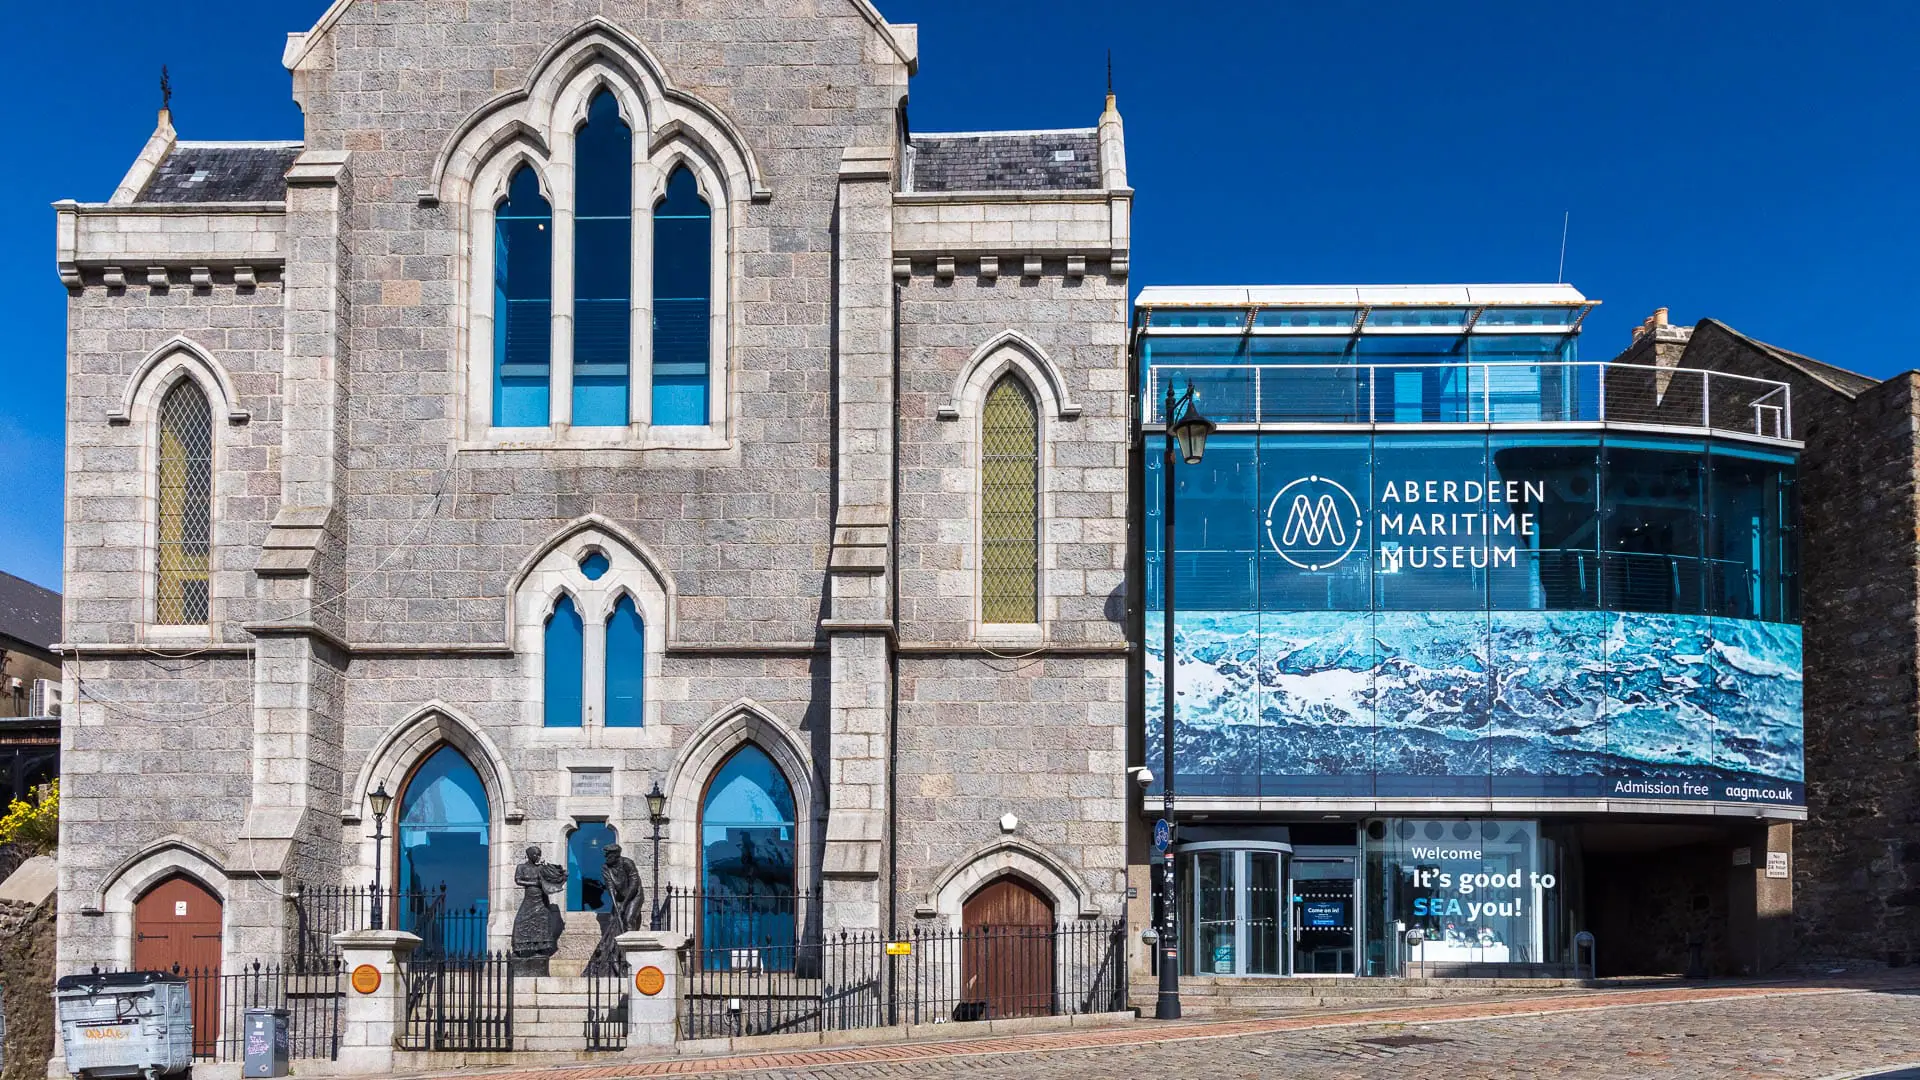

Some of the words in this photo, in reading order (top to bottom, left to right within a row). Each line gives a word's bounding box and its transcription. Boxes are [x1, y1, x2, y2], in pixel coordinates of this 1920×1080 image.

[1381, 480, 1544, 503] ABERDEEN
[1381, 513, 1535, 536] MARITIME
[1381, 545, 1516, 568] MUSEUM
[1614, 780, 1680, 795] Admission
[1683, 781, 1709, 796] free
[1725, 785, 1793, 801] aagm.co.uk
[1411, 846, 1482, 860] Welcome
[1458, 868, 1522, 895] good
[1529, 871, 1556, 889] to
[1413, 897, 1463, 916] SEA
[1466, 897, 1522, 922] you!
